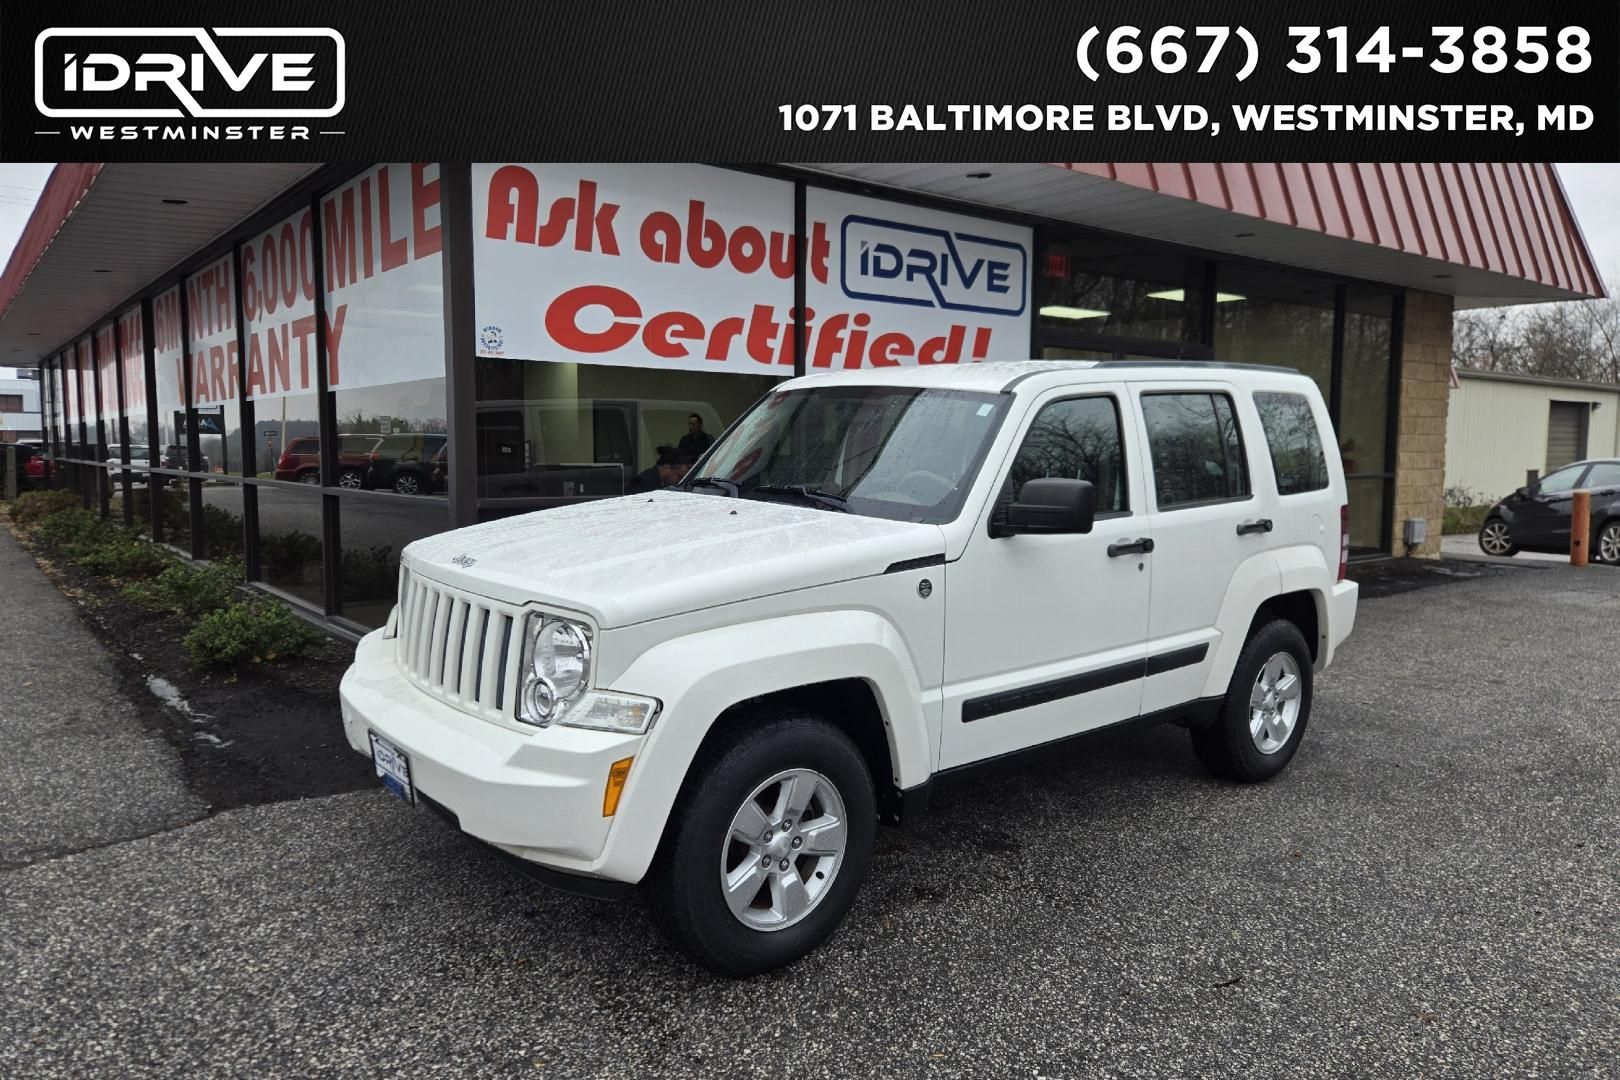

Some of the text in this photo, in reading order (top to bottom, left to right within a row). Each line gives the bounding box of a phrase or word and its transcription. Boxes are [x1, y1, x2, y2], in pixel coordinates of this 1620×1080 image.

[486, 165, 620, 256] Ask
[640, 199, 831, 285] about
[545, 284, 993, 370] Certified!
